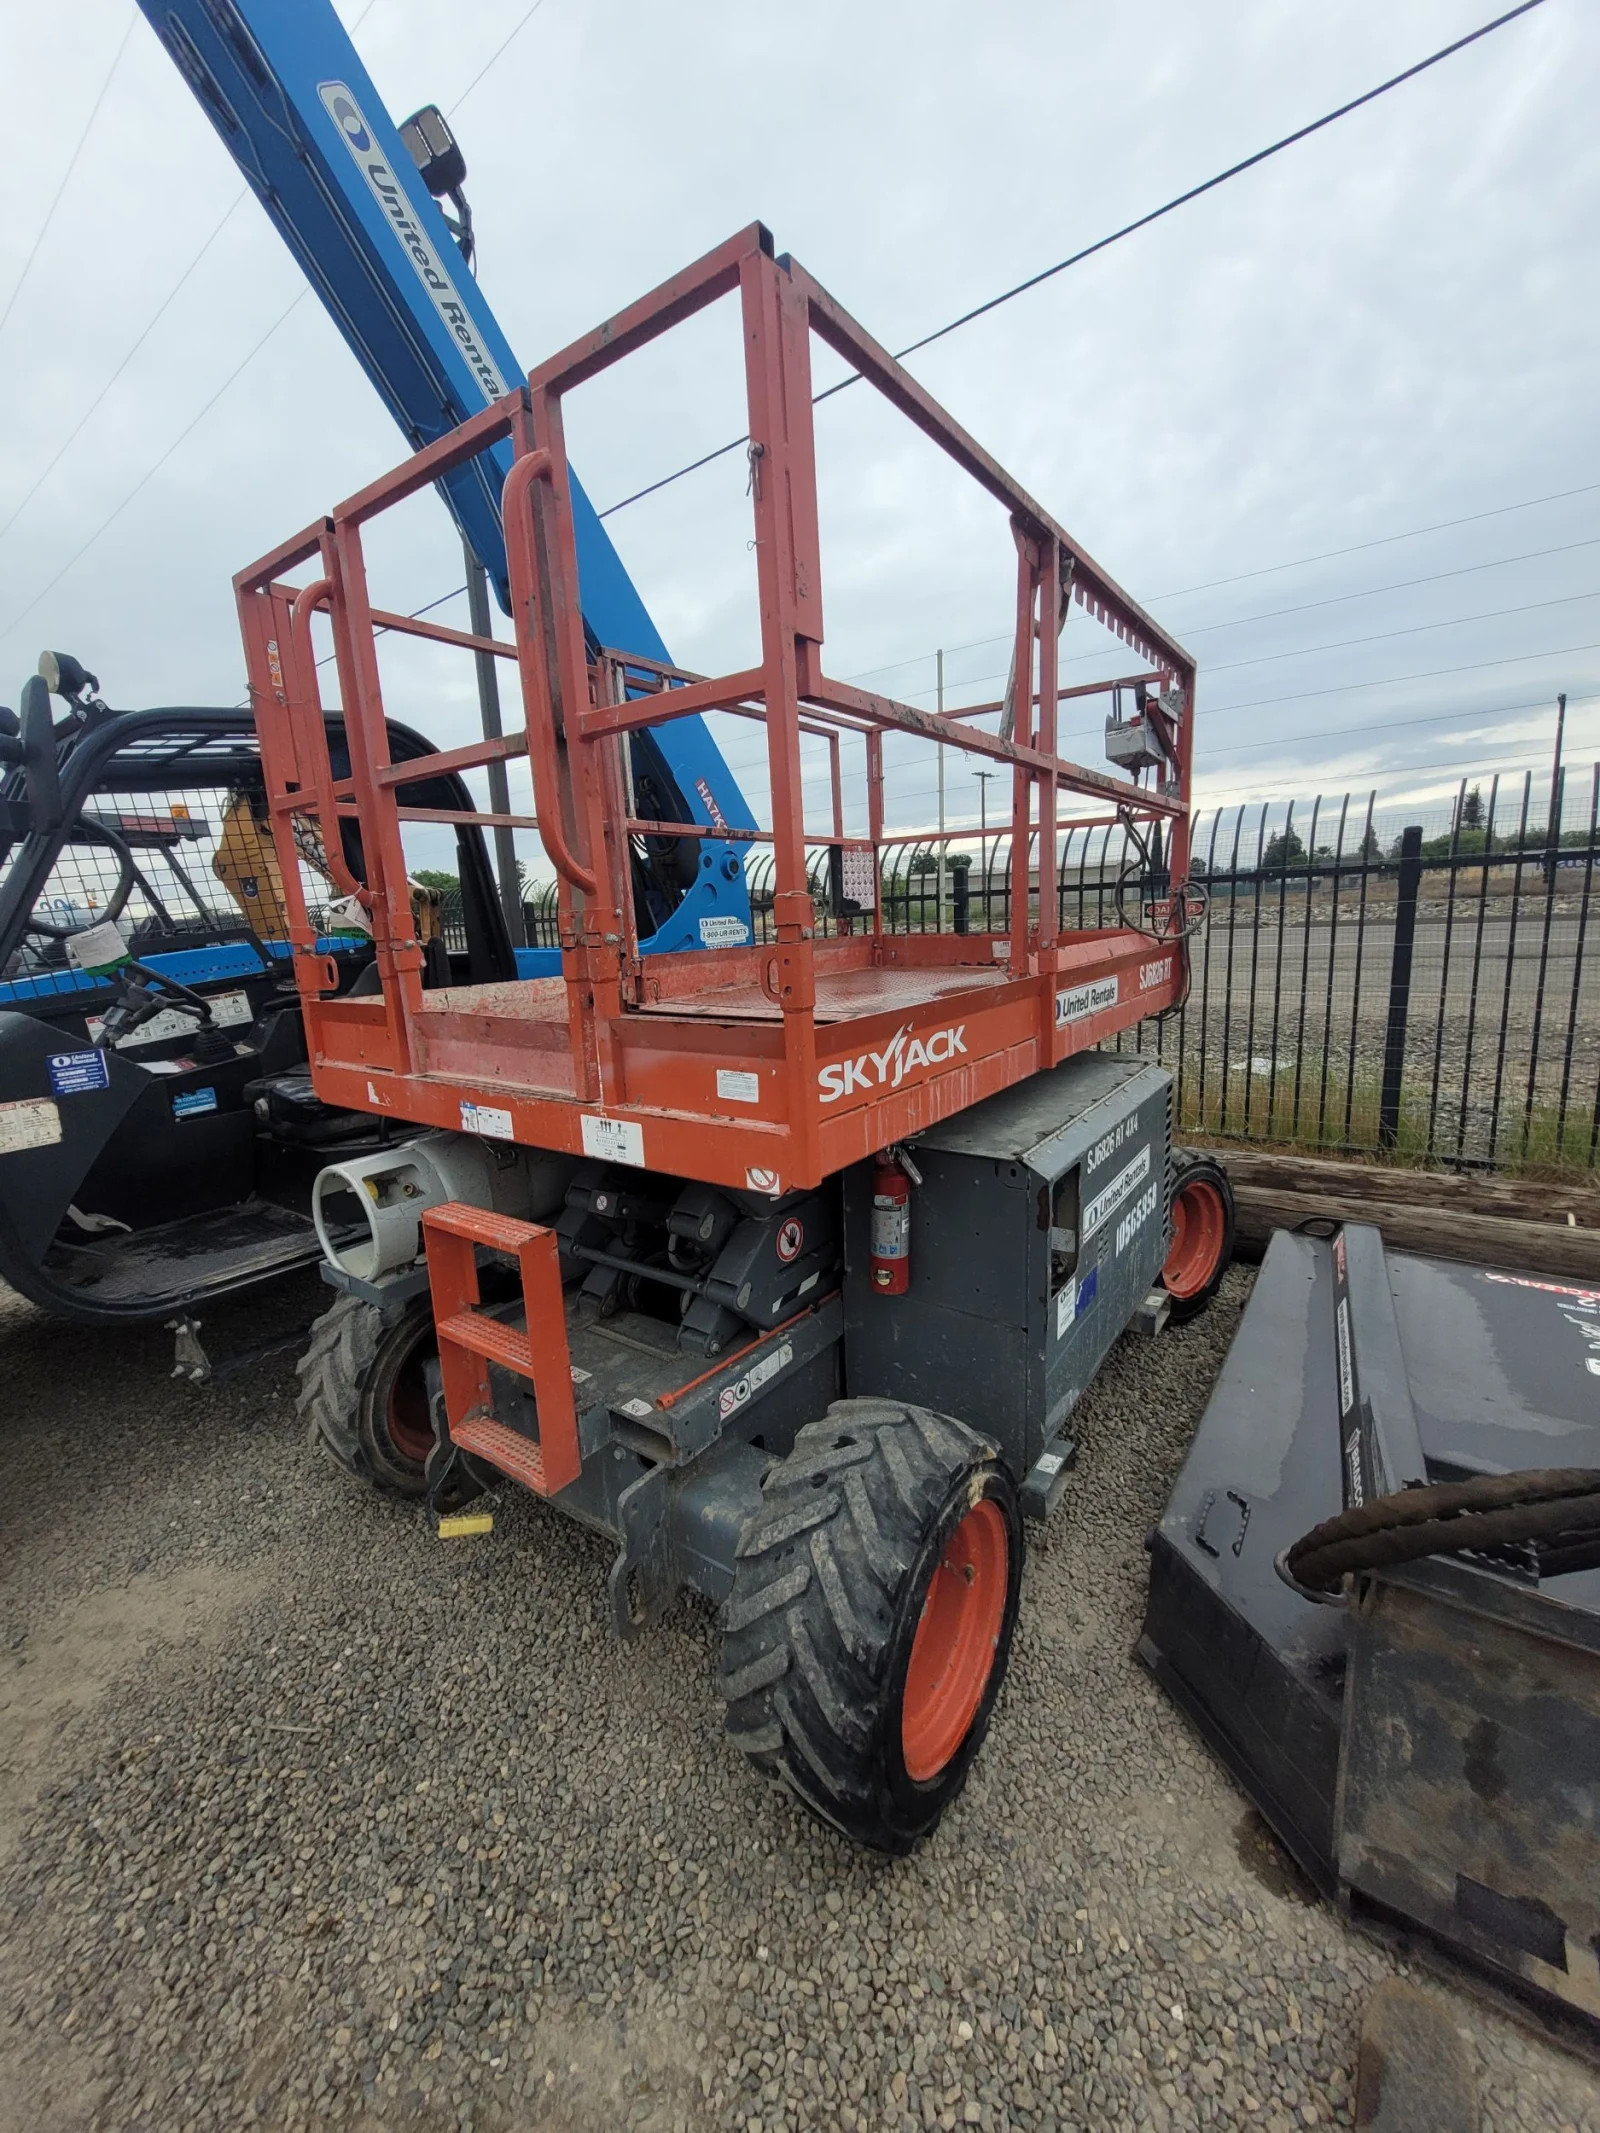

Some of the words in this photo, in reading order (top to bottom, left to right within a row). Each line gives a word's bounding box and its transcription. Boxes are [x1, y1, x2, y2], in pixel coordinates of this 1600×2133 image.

[367, 163, 448, 290] United
[441, 301, 503, 402] Rental
[1154, 905, 1196, 914] DAR
[1062, 989, 1090, 1017] United
[1091, 983, 1116, 1007] Rentals
[1139, 961, 1164, 990] SJ6826
[1163, 957, 1172, 981] RT
[817, 1021, 968, 1103] SKYJACK
[1087, 1132, 1115, 1174] SJ6826
[1115, 1123, 1124, 1149] RT
[1125, 1113, 1138, 1138] 4X4
[1100, 1179, 1123, 1213] United
[1124, 1157, 1147, 1188] Rentals
[1115, 1181, 1157, 1258] 10565958
